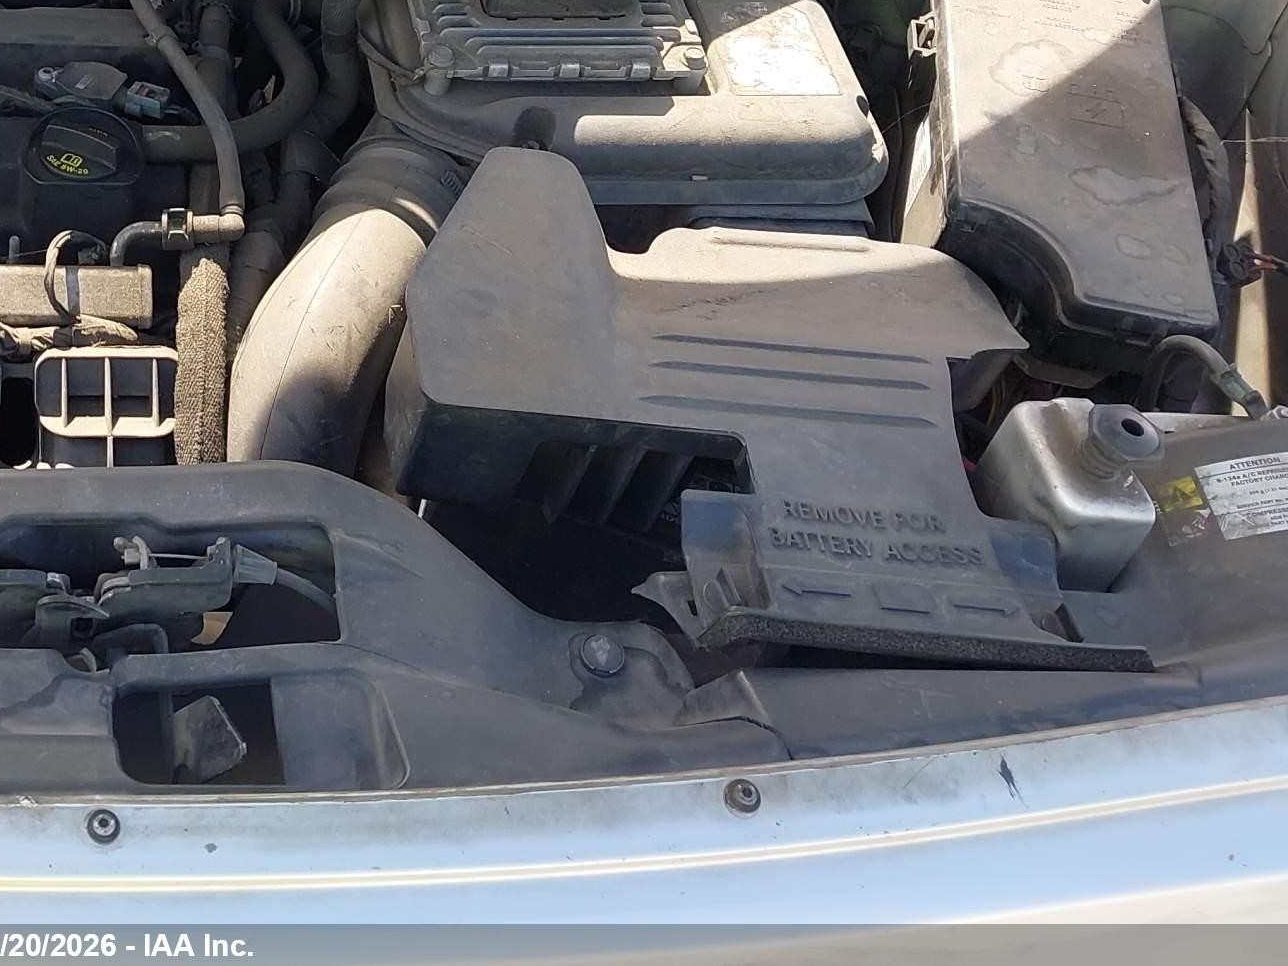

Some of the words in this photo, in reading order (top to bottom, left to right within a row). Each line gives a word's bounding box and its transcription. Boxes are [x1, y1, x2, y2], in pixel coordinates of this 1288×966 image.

[1229, 457, 1281, 470] ATTENTION
[783, 500, 886, 530] REMOVE
[894, 512, 946, 534] FOR
[768, 527, 873, 557] BATTERY
[883, 543, 985, 566] ACCESS
